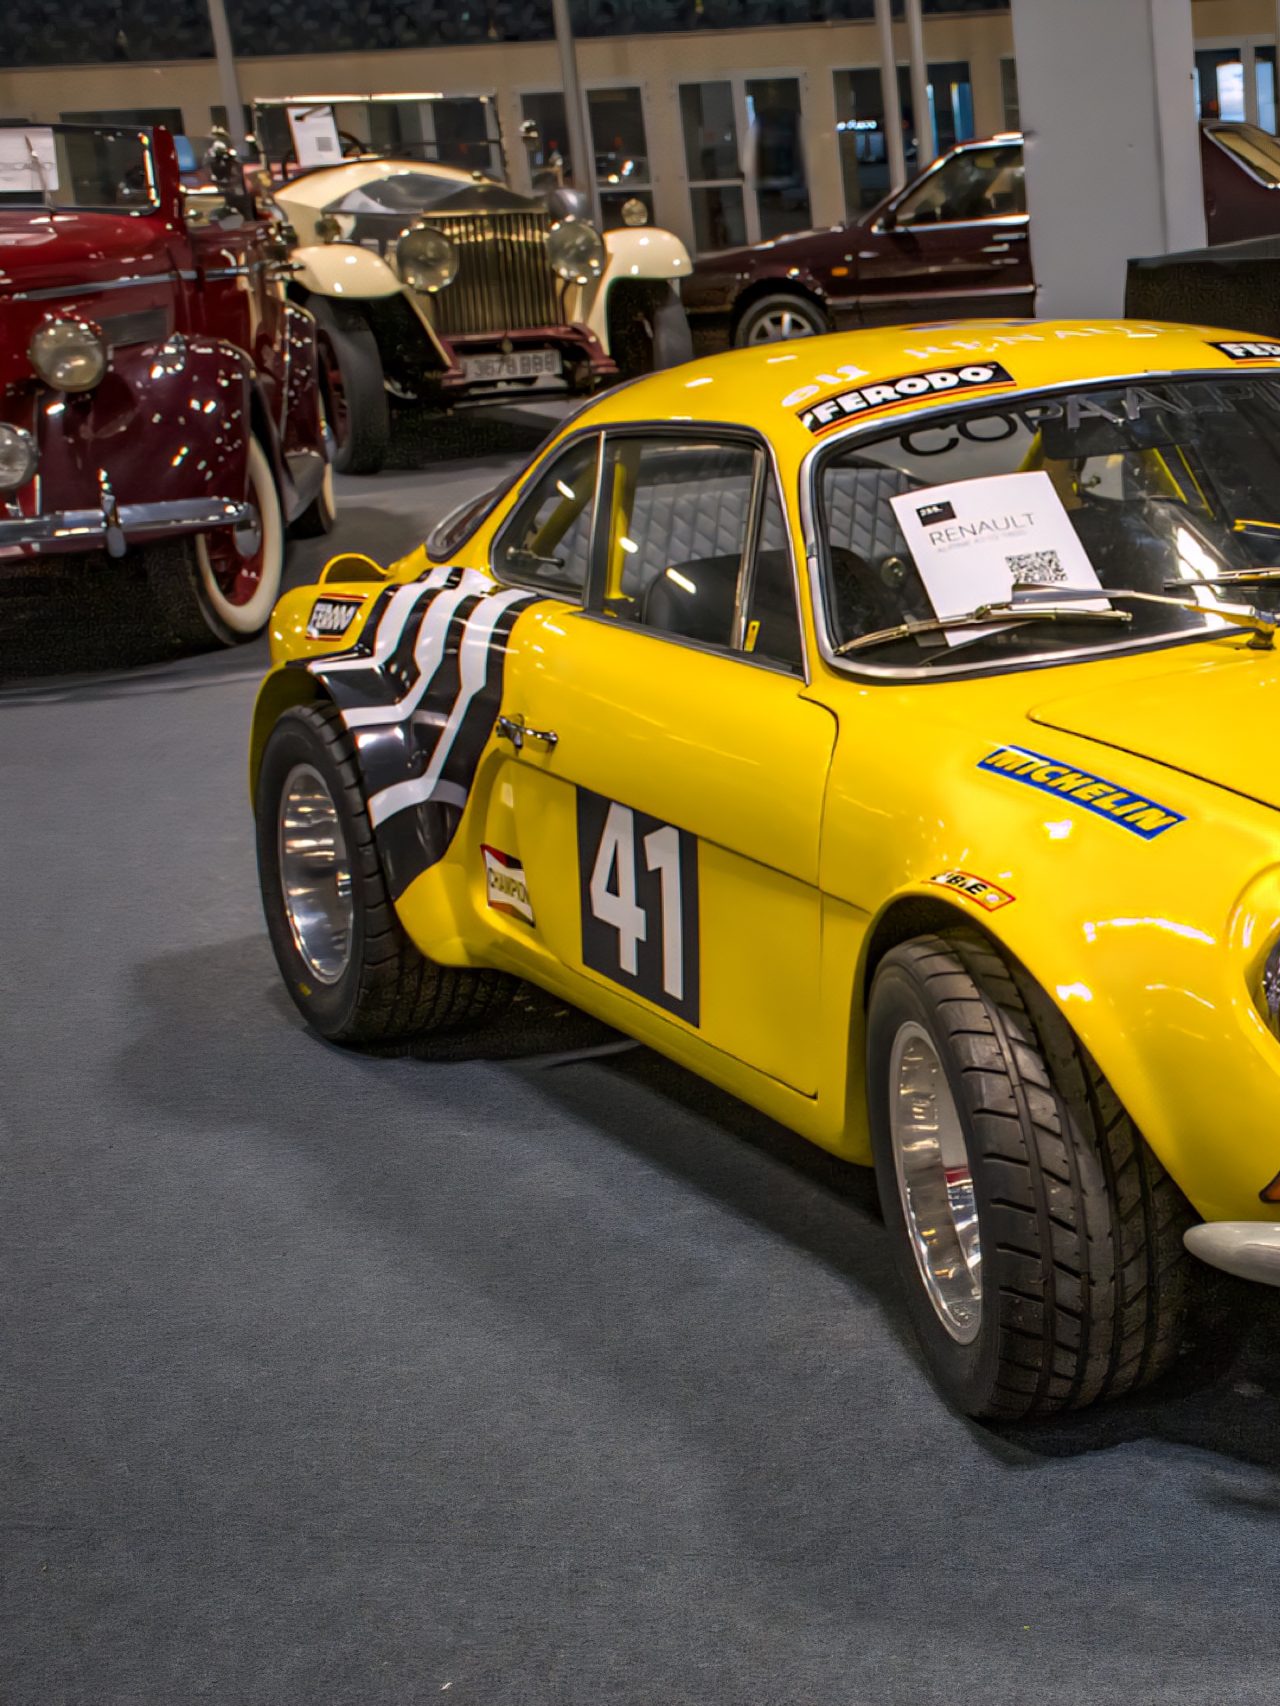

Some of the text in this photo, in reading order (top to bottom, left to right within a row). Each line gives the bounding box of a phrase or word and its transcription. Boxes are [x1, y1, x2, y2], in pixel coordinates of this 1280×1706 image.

[816, 366, 994, 424] FERODO
[929, 512, 1035, 546] RENAULT
[984, 750, 1179, 832] MICHELIN
[590, 801, 684, 1001] 41
